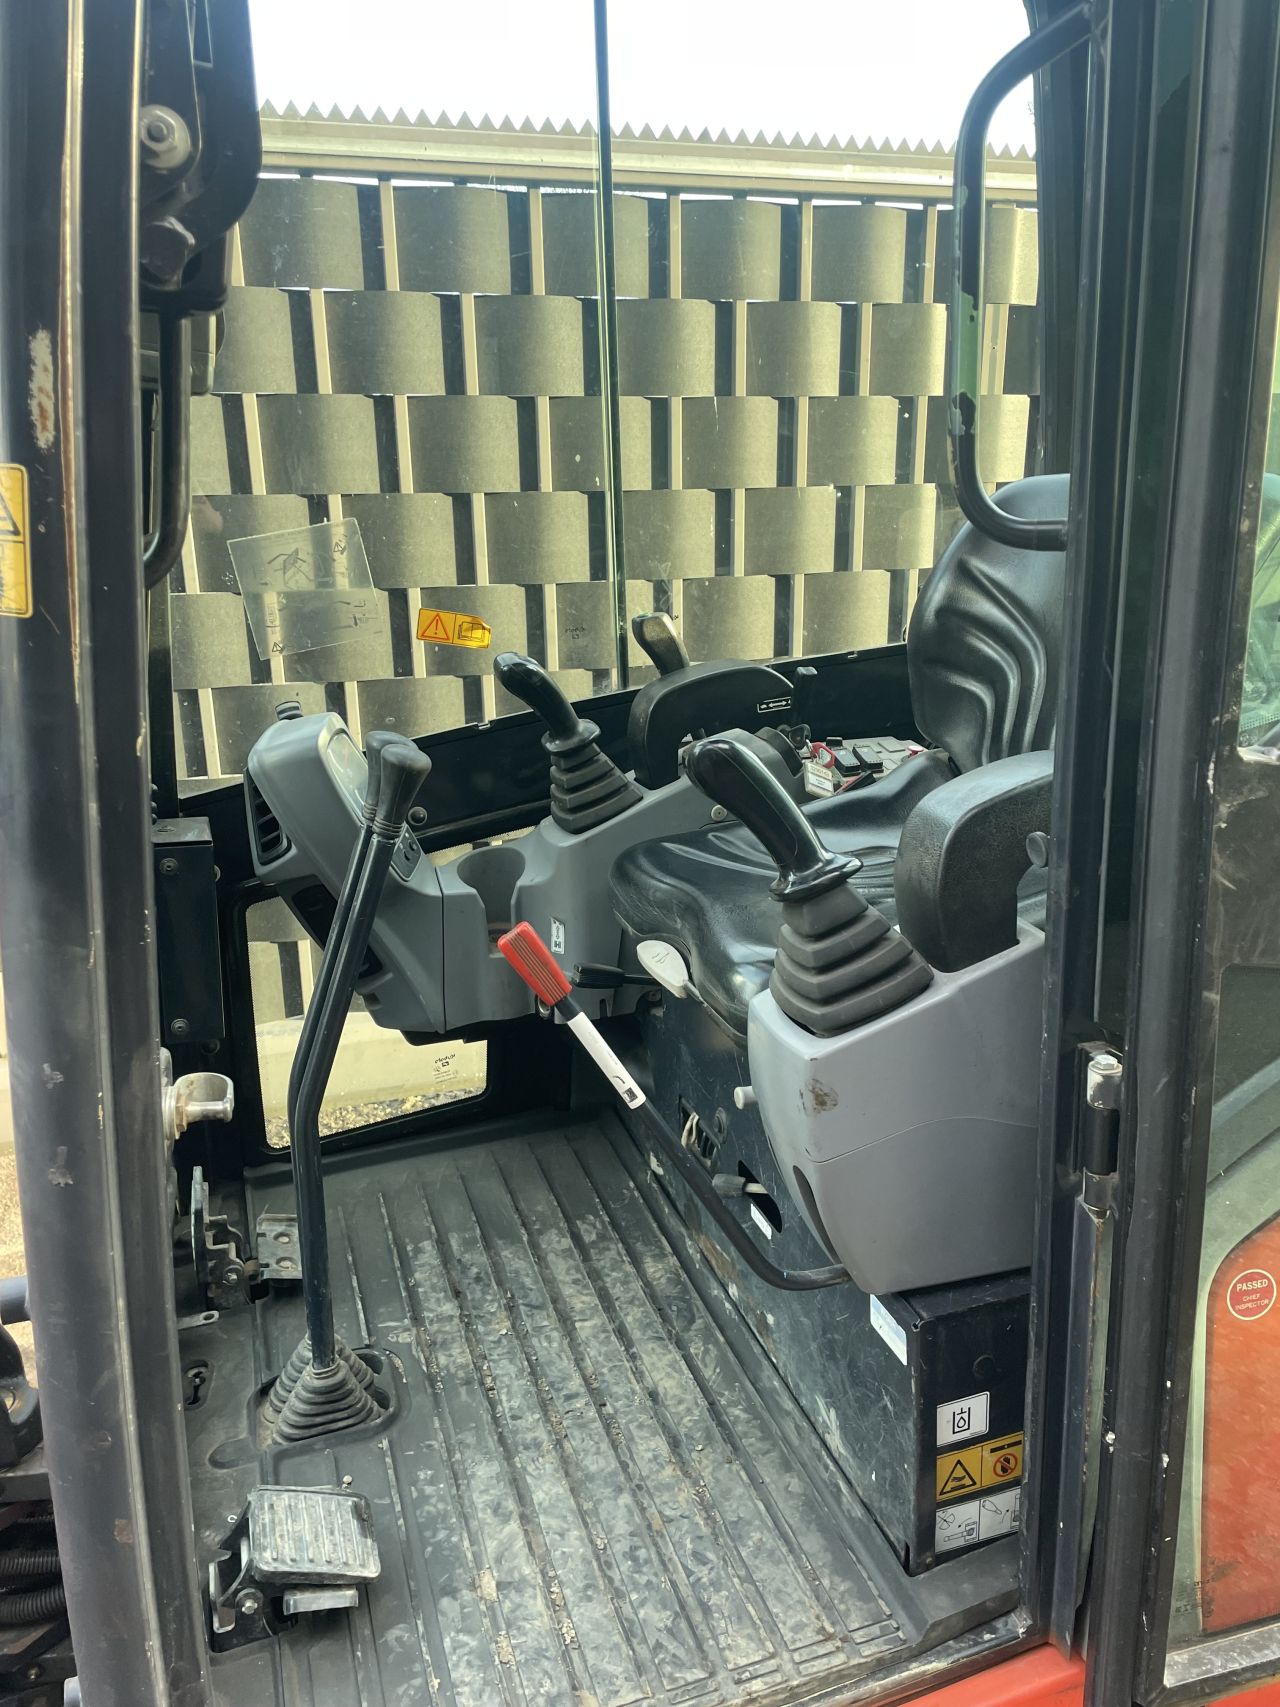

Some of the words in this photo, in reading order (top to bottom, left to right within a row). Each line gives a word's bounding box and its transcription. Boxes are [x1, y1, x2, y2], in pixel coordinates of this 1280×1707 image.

[1236, 1279, 1268, 1292] PASSED
[1243, 1293, 1260, 1302] CHIEF
[1235, 1299, 1269, 1310] INSPECTOR
